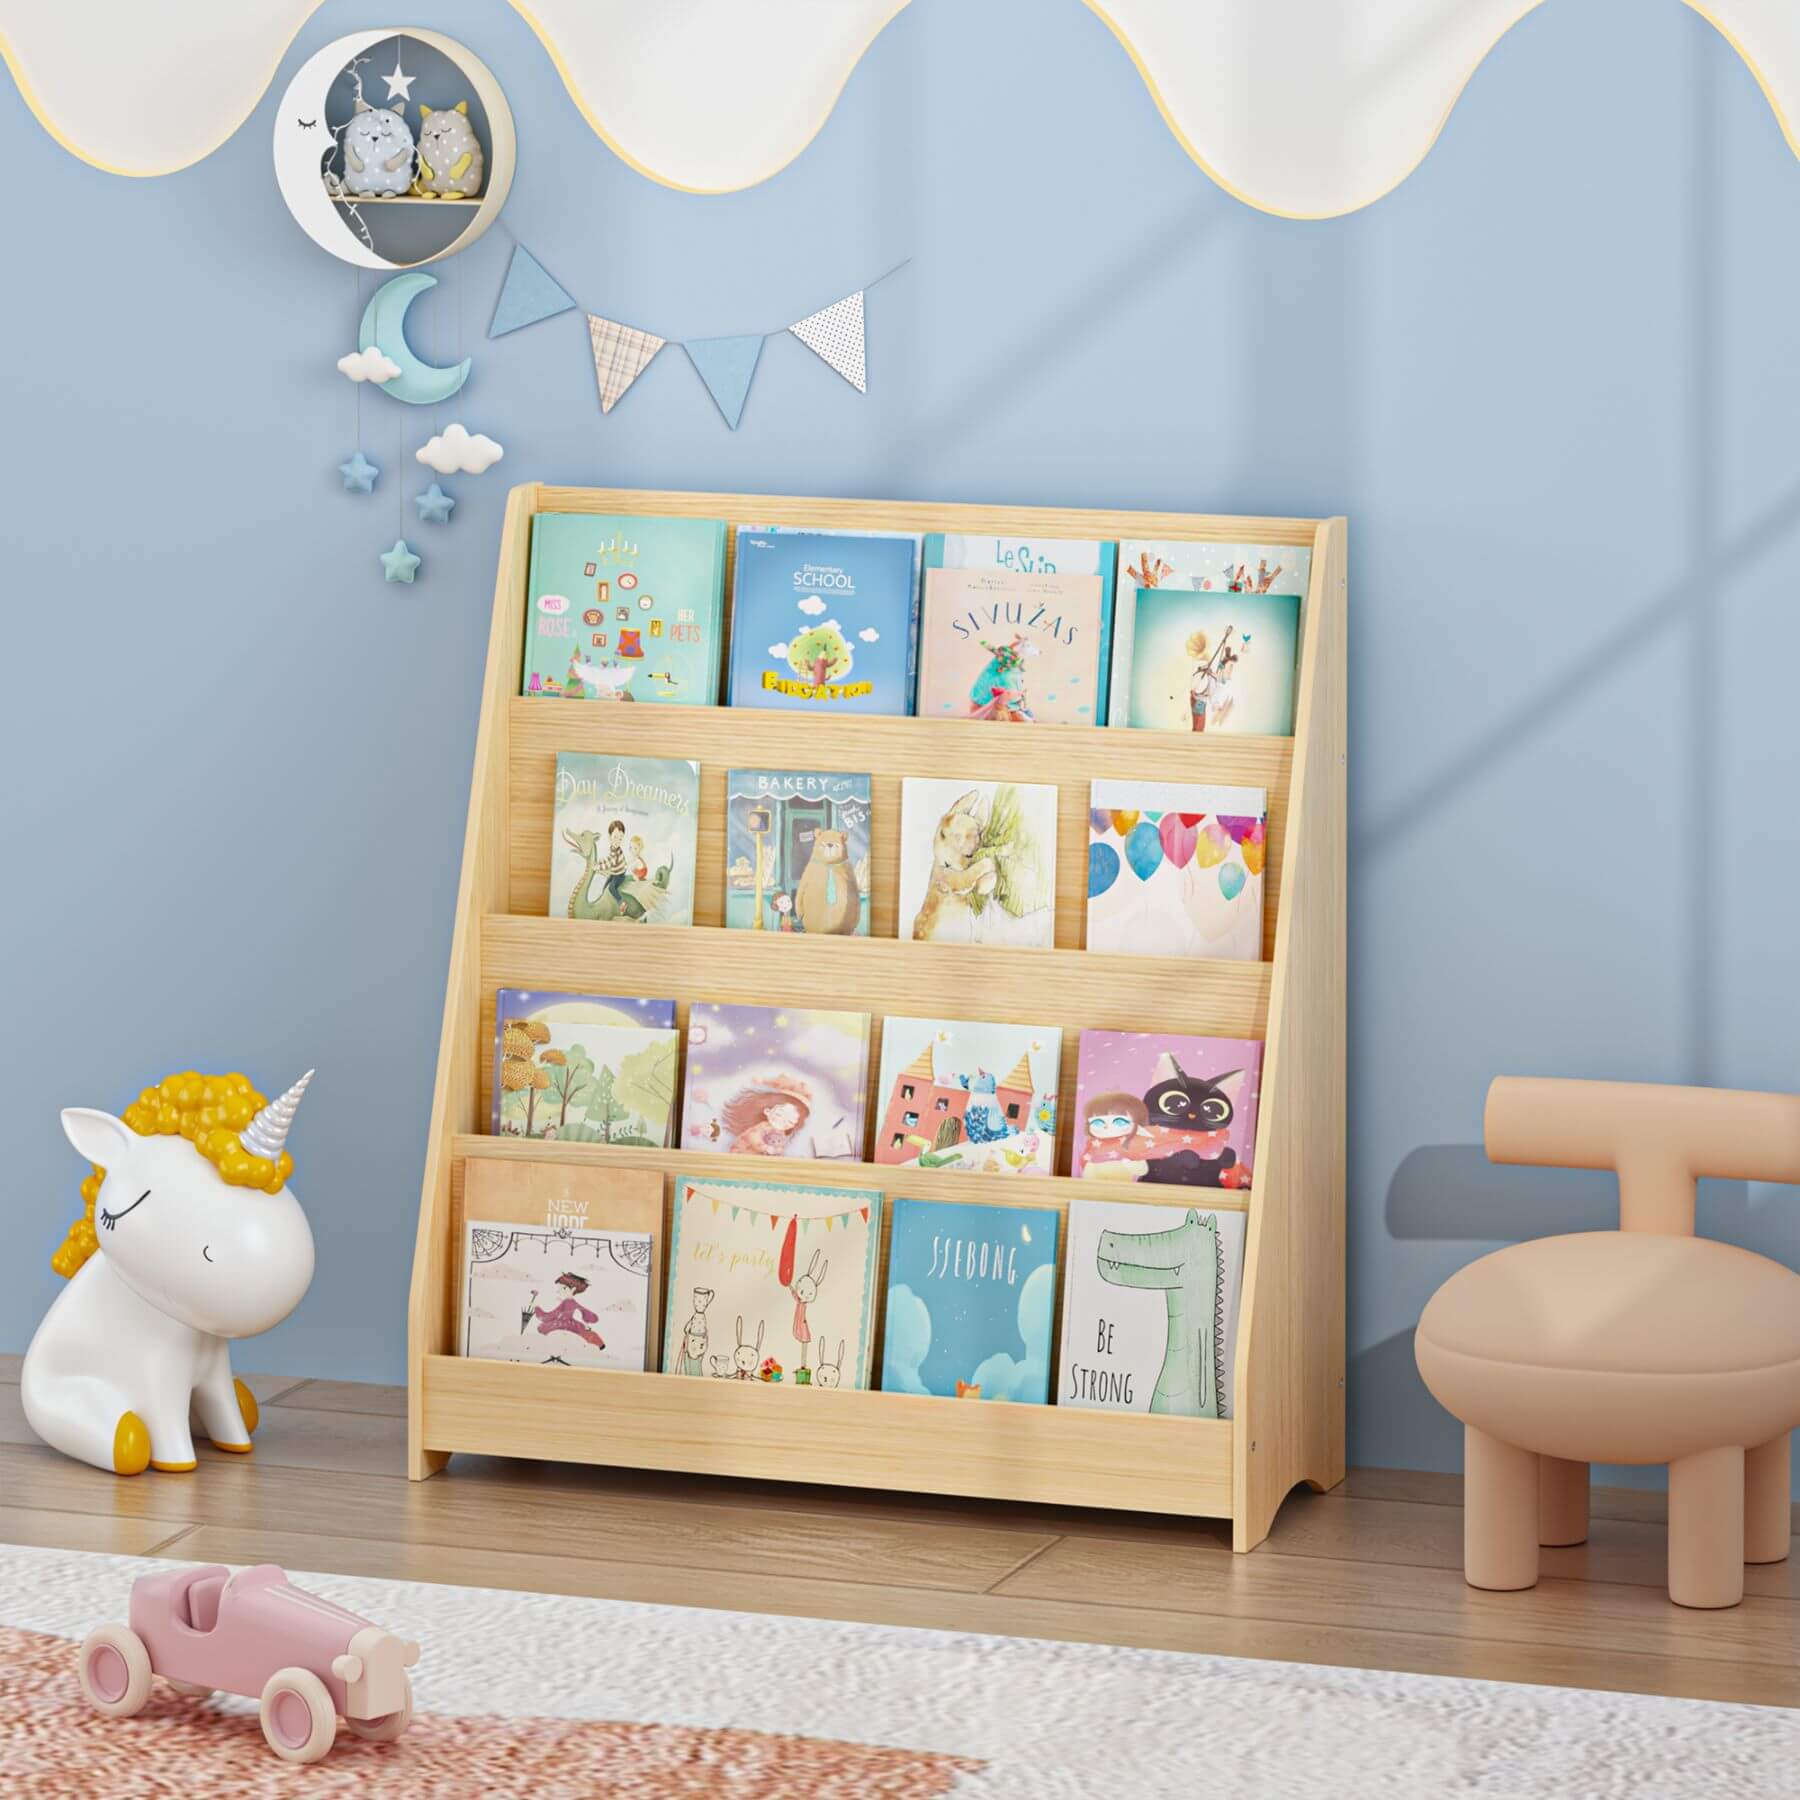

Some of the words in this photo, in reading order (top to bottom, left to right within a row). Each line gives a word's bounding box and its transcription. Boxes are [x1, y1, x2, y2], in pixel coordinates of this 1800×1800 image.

[996, 539, 1013, 568] Le
[803, 564, 843, 574] Elementary
[793, 571, 856, 589] SCHOOL
[669, 624, 701, 642] PETS
[758, 775, 829, 791] BAKERY
[548, 1199, 589, 1213] NEW
[927, 1236, 1017, 1285] SSEBONG
[1097, 1318, 1115, 1355] BE
[1070, 1363, 1133, 1405] STRONG
